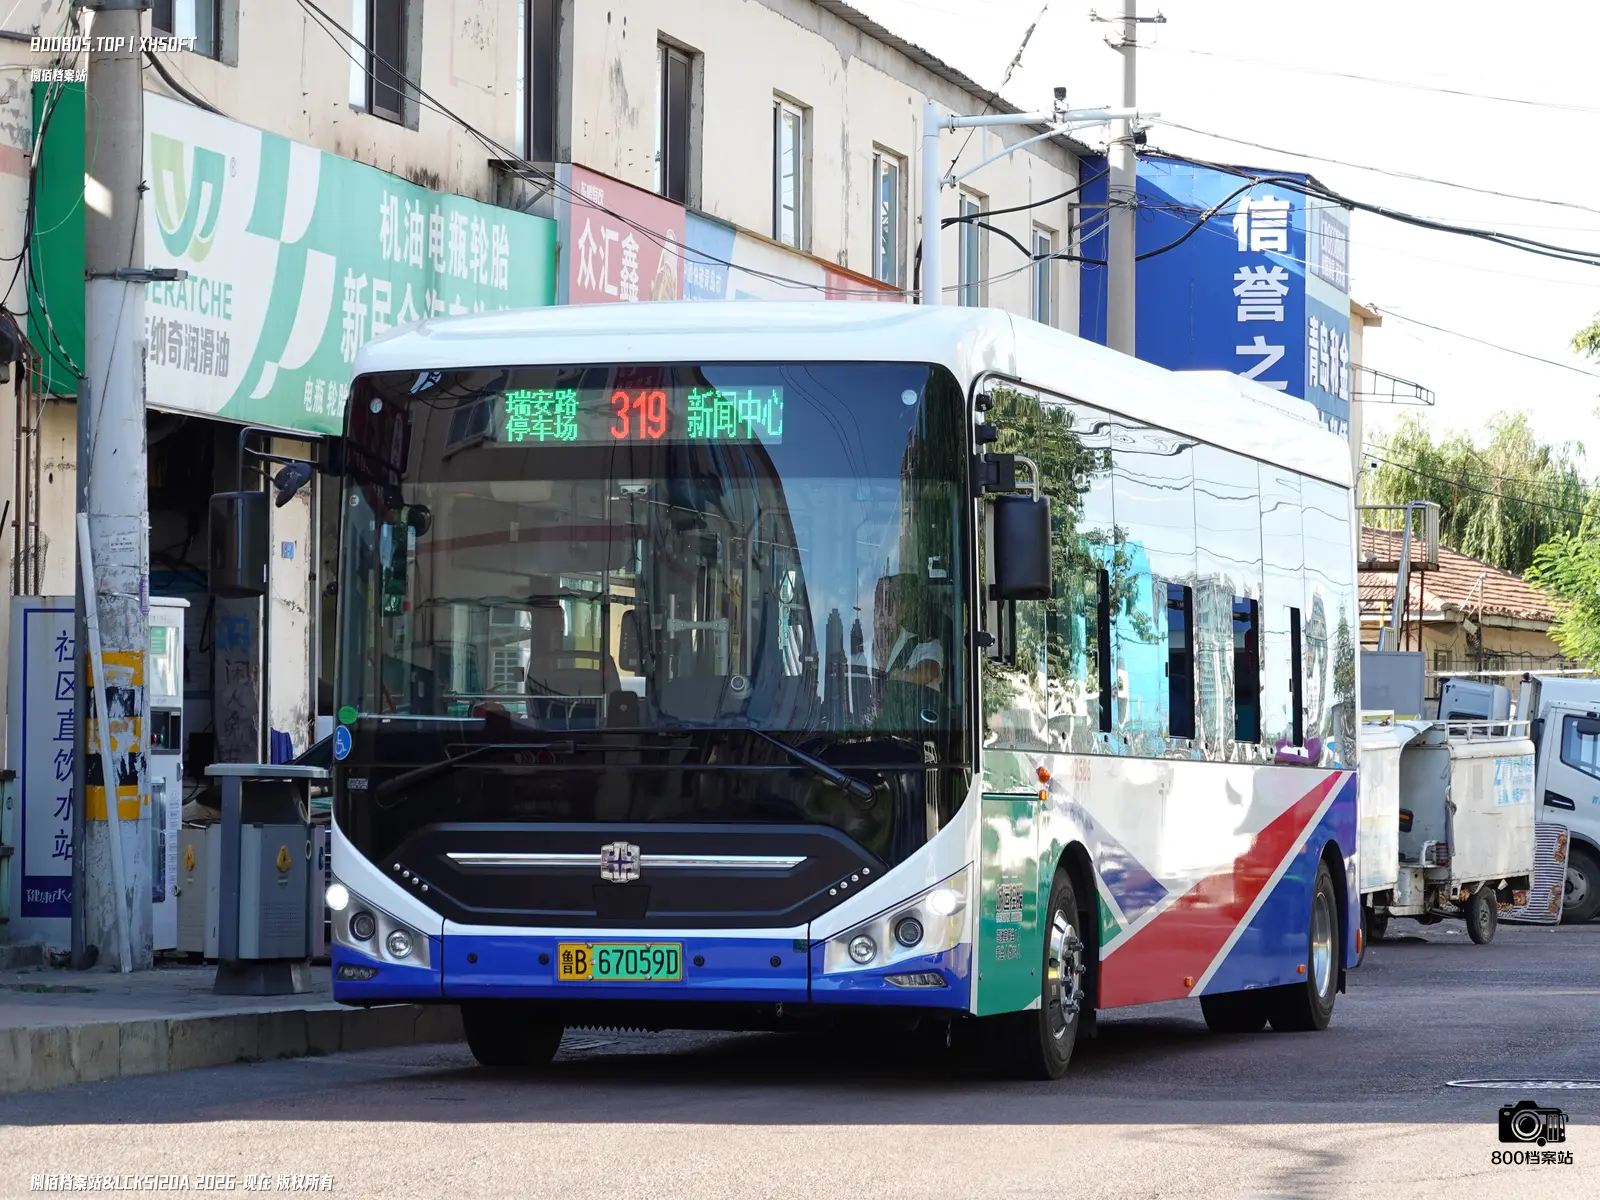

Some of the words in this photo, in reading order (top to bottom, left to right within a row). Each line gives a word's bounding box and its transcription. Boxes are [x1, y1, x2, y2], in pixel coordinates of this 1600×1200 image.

[379, 189, 511, 291] 机油电瓶轮胎
[577, 217, 640, 303] 众汇鑫
[145, 316, 230, 378] 纳奇润滑油
[505, 389, 579, 416] 瑞安路
[610, 391, 667, 439] 319
[687, 387, 784, 439] 新闻中心
[505, 415, 579, 442] 停车场
[562, 949, 588, 975] 鲁B
[598, 949, 679, 975] 67059D
